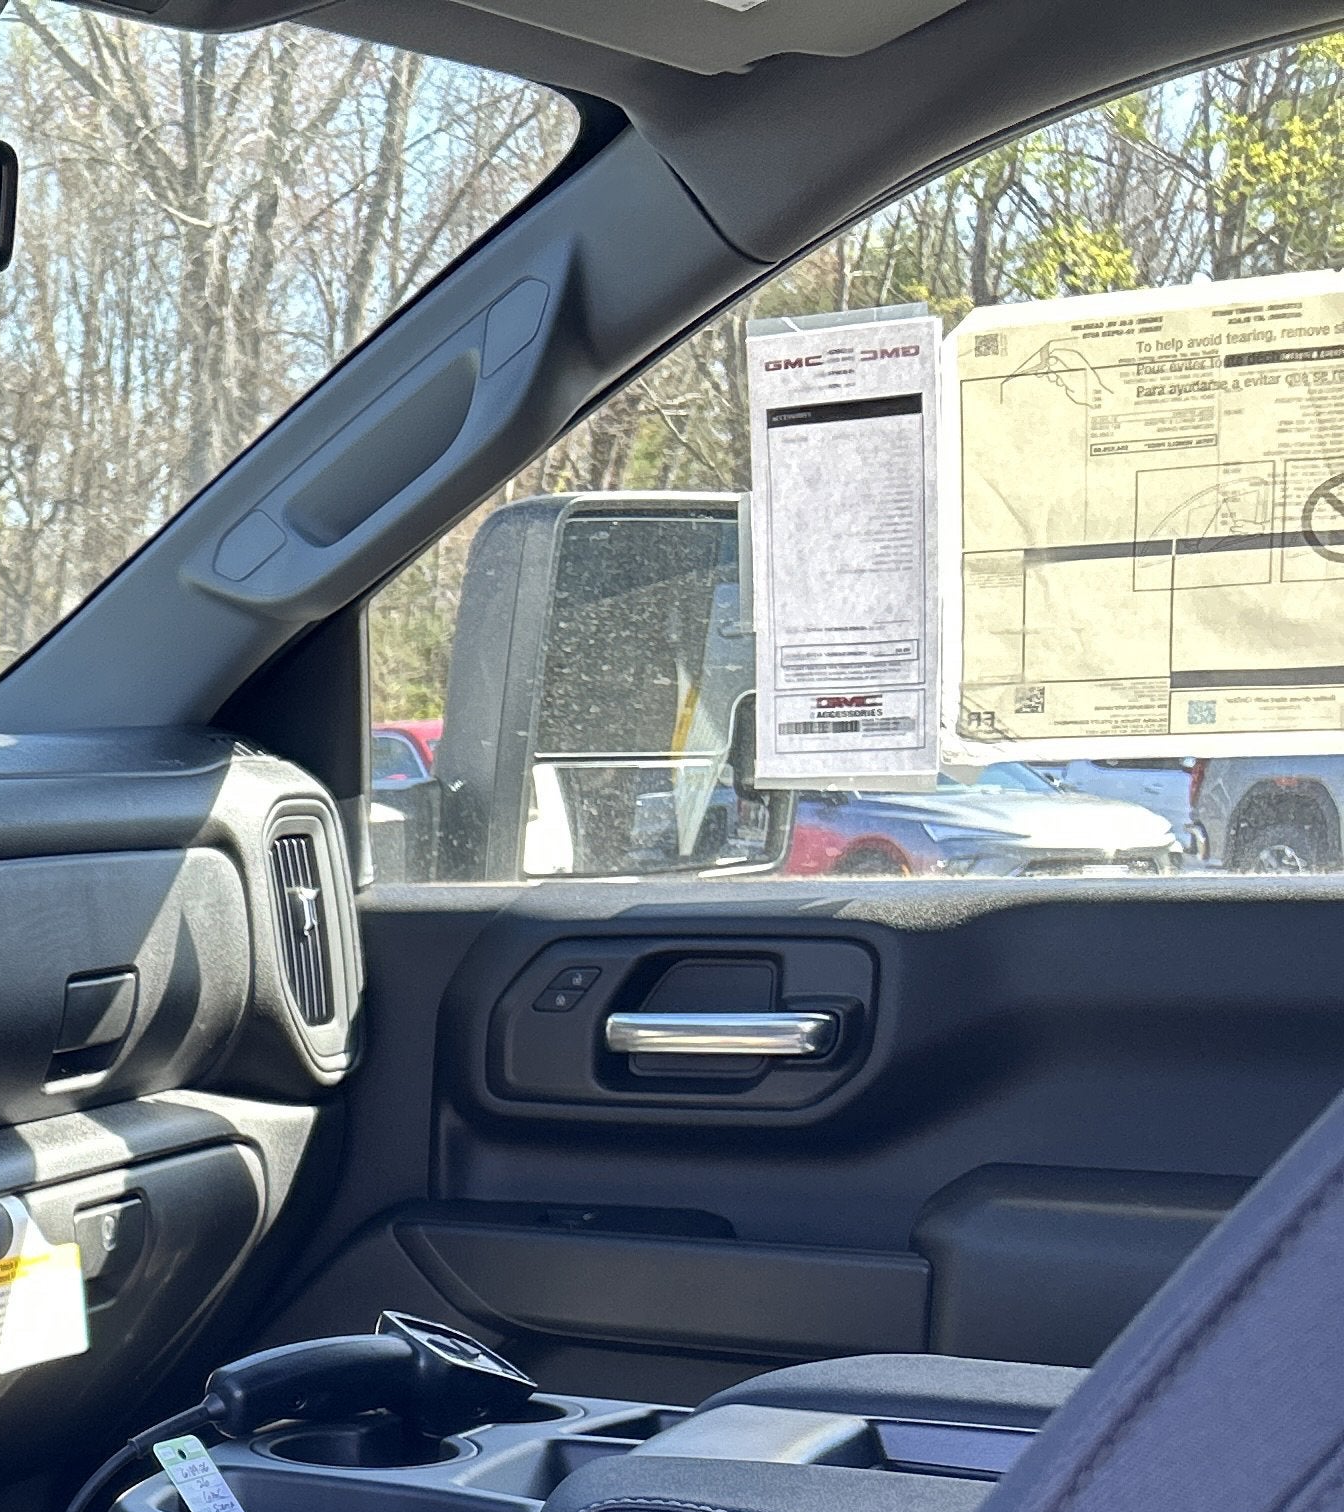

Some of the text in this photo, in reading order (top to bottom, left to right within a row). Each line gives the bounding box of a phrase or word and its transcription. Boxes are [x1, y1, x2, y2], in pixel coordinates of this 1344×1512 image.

[1136, 341, 1153, 354] To
[1156, 338, 1183, 353] help
[1187, 333, 1222, 349] avoid
[1226, 327, 1277, 345] tearing,
[1281, 325, 1330, 339] remove
[764, 355, 824, 372] GMC
[1136, 384, 1165, 398] Para
[1244, 374, 1281, 388] evitar
